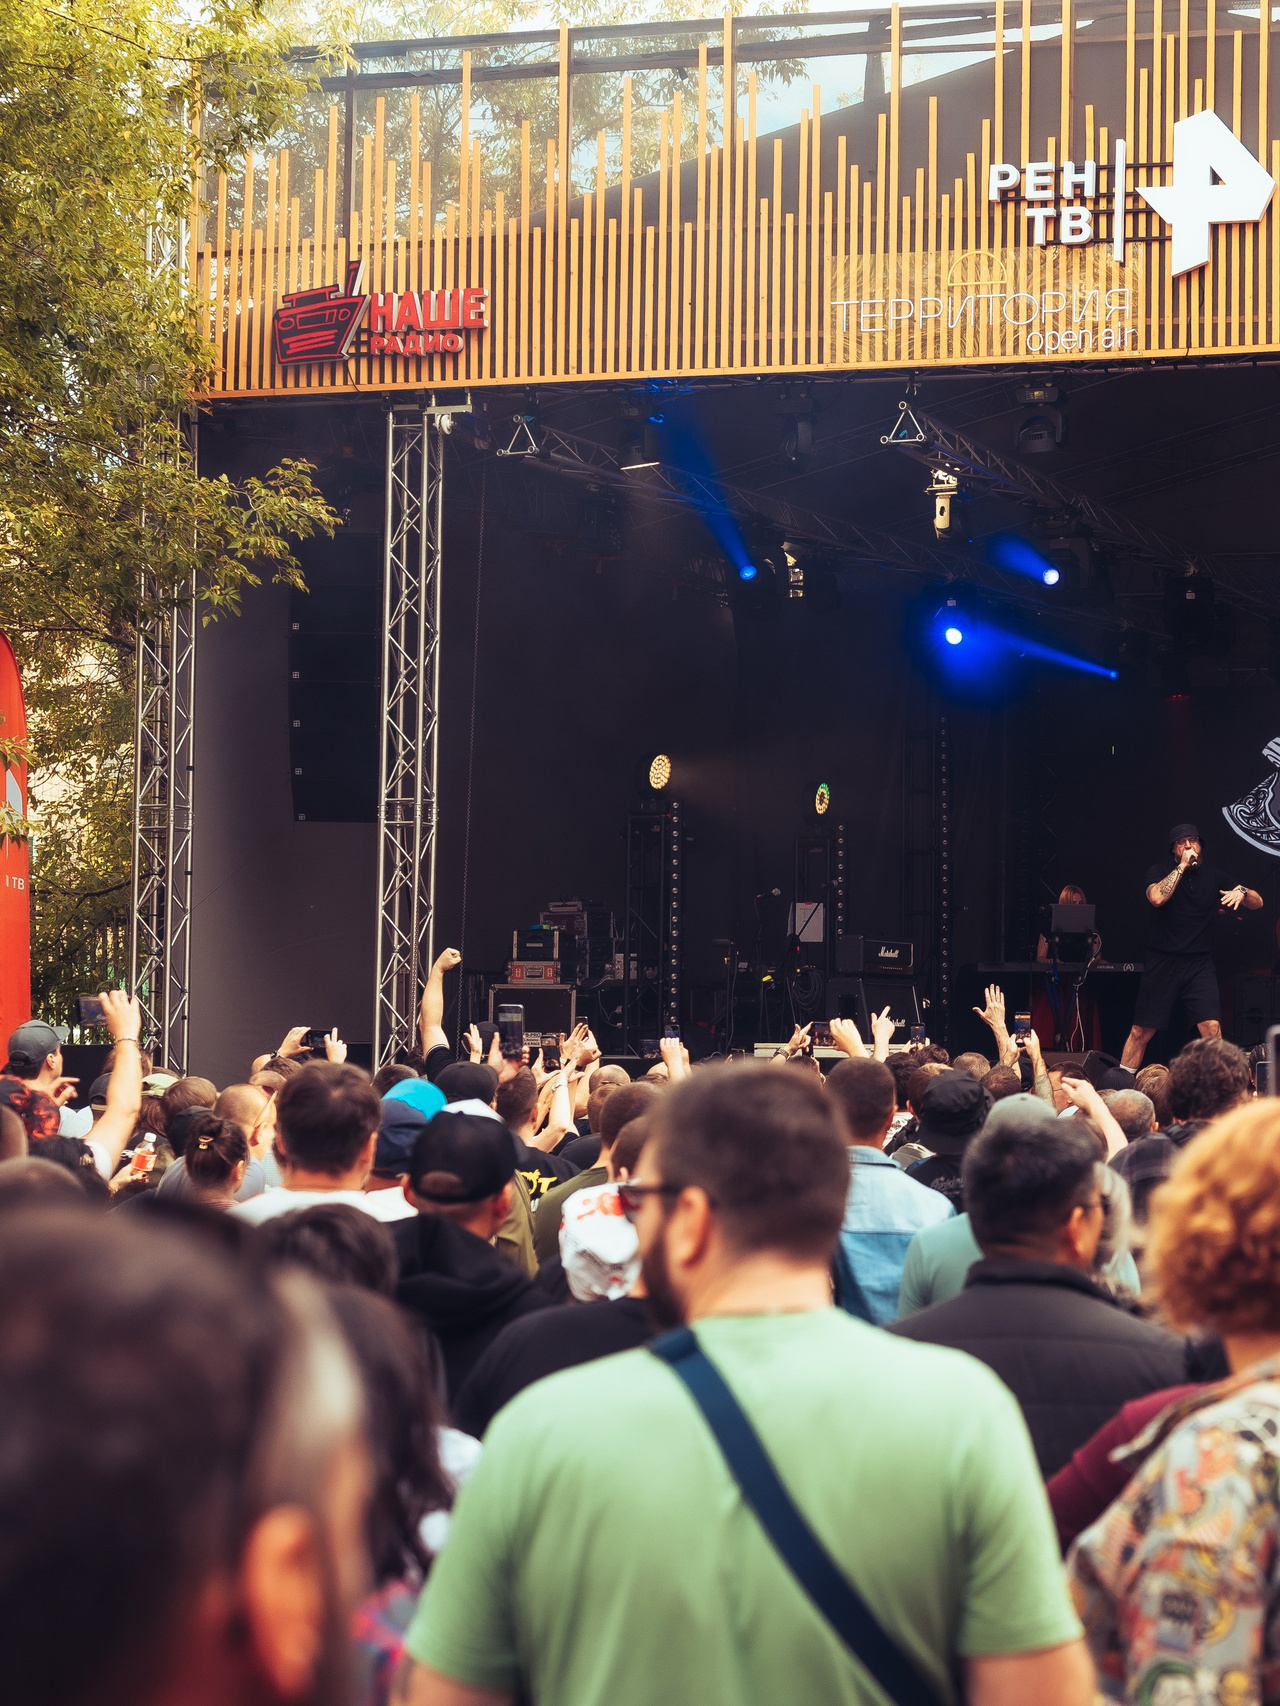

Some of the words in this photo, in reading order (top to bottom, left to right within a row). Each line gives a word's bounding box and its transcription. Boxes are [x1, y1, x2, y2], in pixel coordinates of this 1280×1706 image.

[989, 160, 1096, 202] РЕН
[1025, 206, 1094, 246] ТВ
[370, 287, 489, 333] НАШЕ
[831, 287, 1131, 333] ТЕРРИТОРИЯ
[370, 333, 464, 357] РАДИО
[1026, 325, 1093, 357] open
[1101, 321, 1139, 350] air
[11, 876, 25, 890] ТВ
